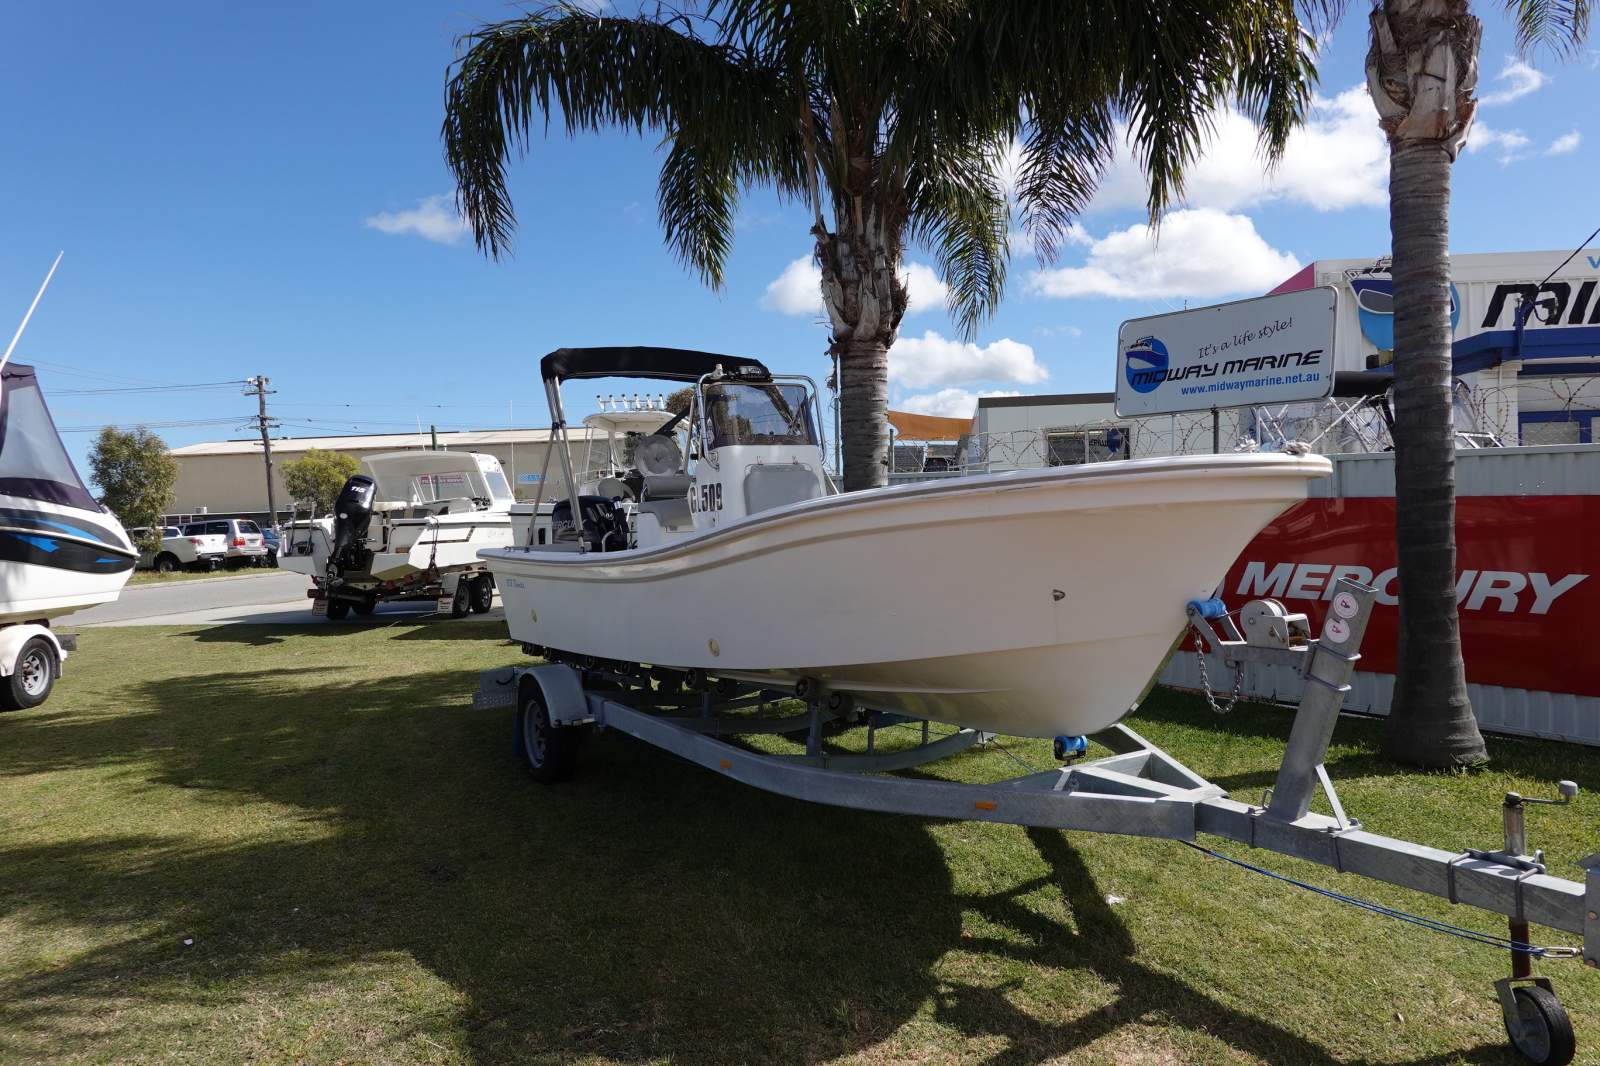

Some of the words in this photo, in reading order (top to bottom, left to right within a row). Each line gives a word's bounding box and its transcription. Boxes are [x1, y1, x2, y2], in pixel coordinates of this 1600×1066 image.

[1481, 281, 1600, 328] MI
[1198, 345, 1217, 359] It's
[1220, 341, 1231, 351] a
[1233, 332, 1256, 347] life
[1258, 317, 1293, 341] style!
[1131, 362, 1219, 385] MIDWAY
[1222, 349, 1324, 375] MARINE
[1181, 372, 1320, 396] www.midwaymarine.net.au
